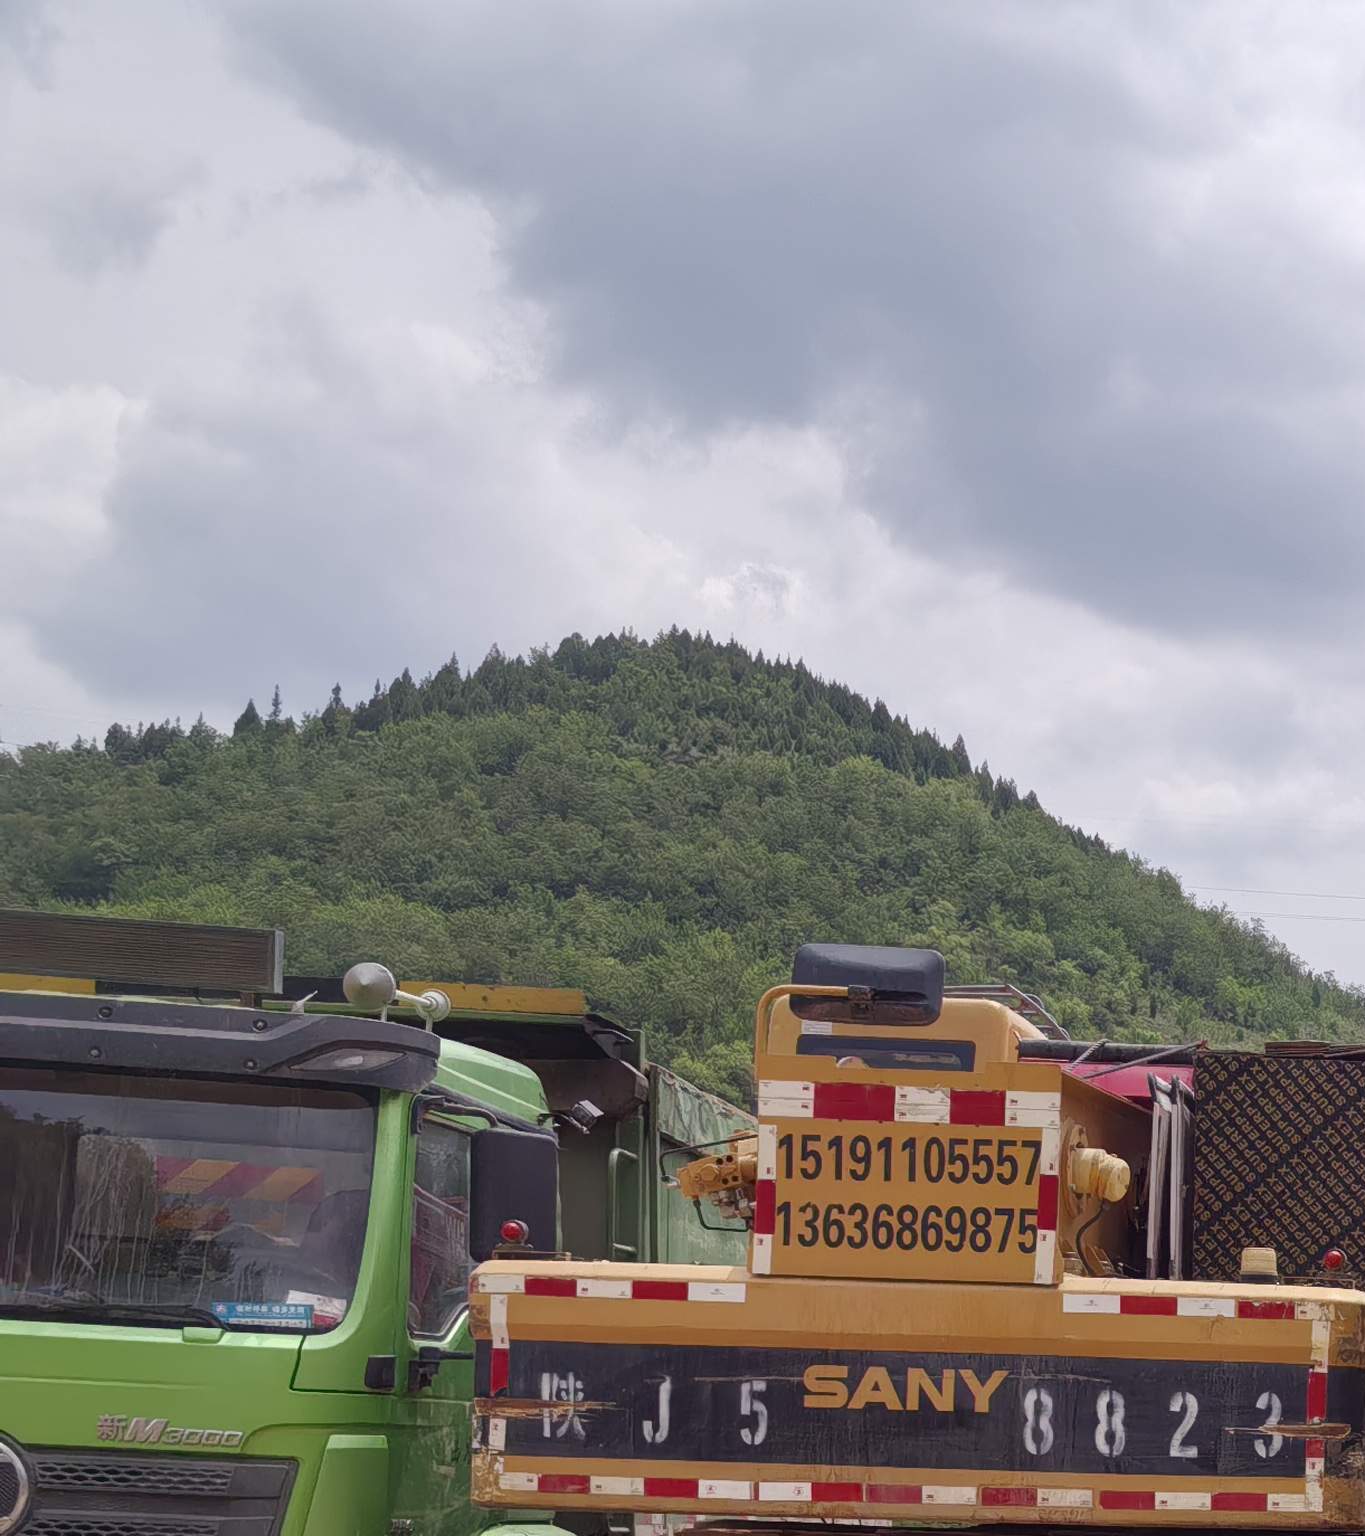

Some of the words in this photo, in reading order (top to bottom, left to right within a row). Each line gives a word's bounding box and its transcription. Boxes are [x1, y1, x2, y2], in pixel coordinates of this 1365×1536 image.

[778, 1134, 1042, 1187] 15191105557
[777, 1200, 1038, 1256] 13636869875
[540, 1371, 586, 1442] 陕
[803, 1364, 1008, 1414] SANY
